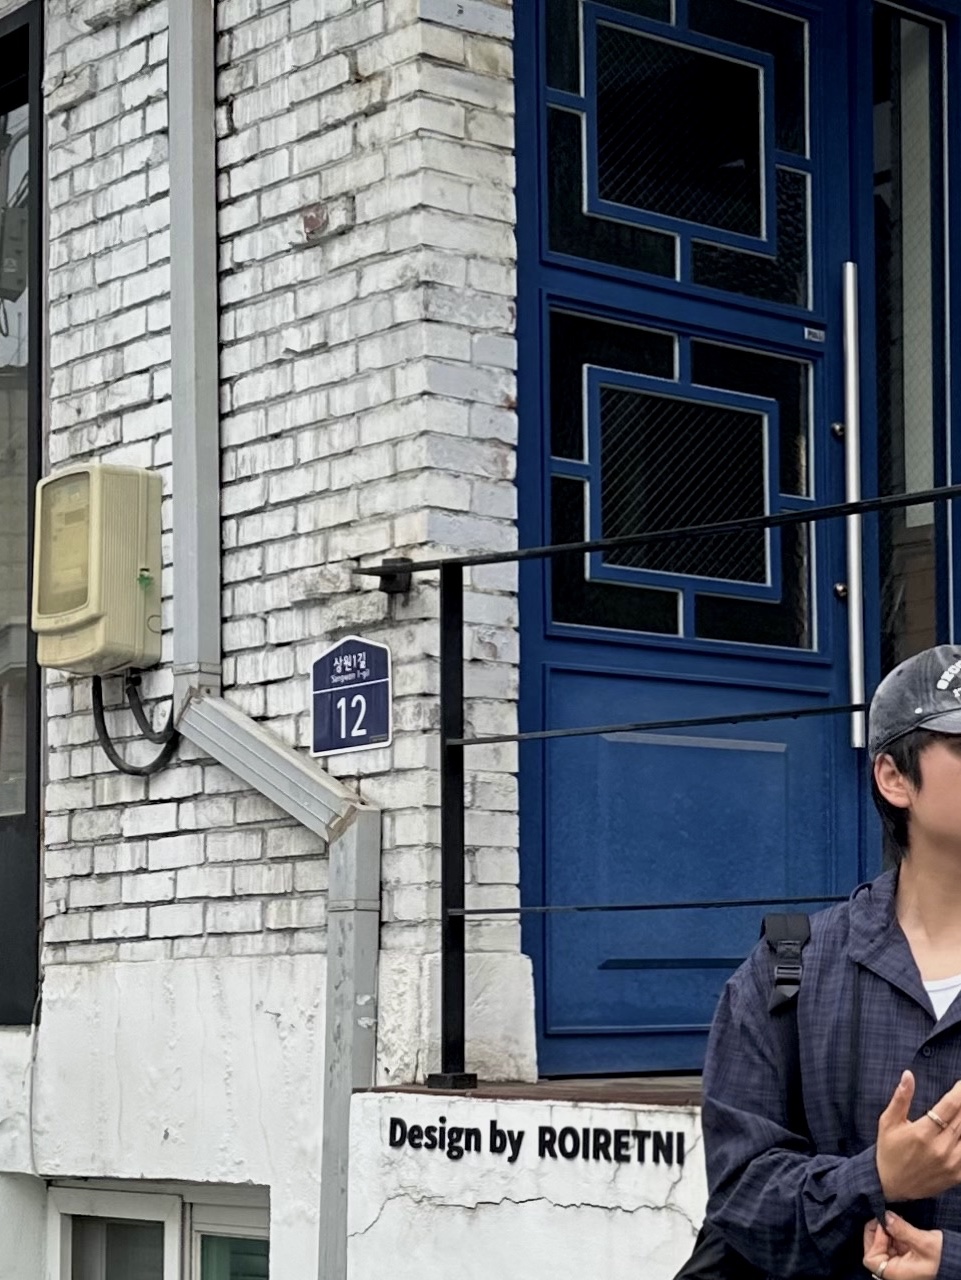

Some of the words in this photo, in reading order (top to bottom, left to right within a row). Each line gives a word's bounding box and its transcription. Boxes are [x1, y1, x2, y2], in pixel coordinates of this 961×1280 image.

[333, 652, 367, 673] 상원1길
[336, 694, 367, 739] 12
[389, 1116, 481, 1159] Design
[489, 1119, 526, 1163] by
[538, 1125, 685, 1165] ROIRETNI
